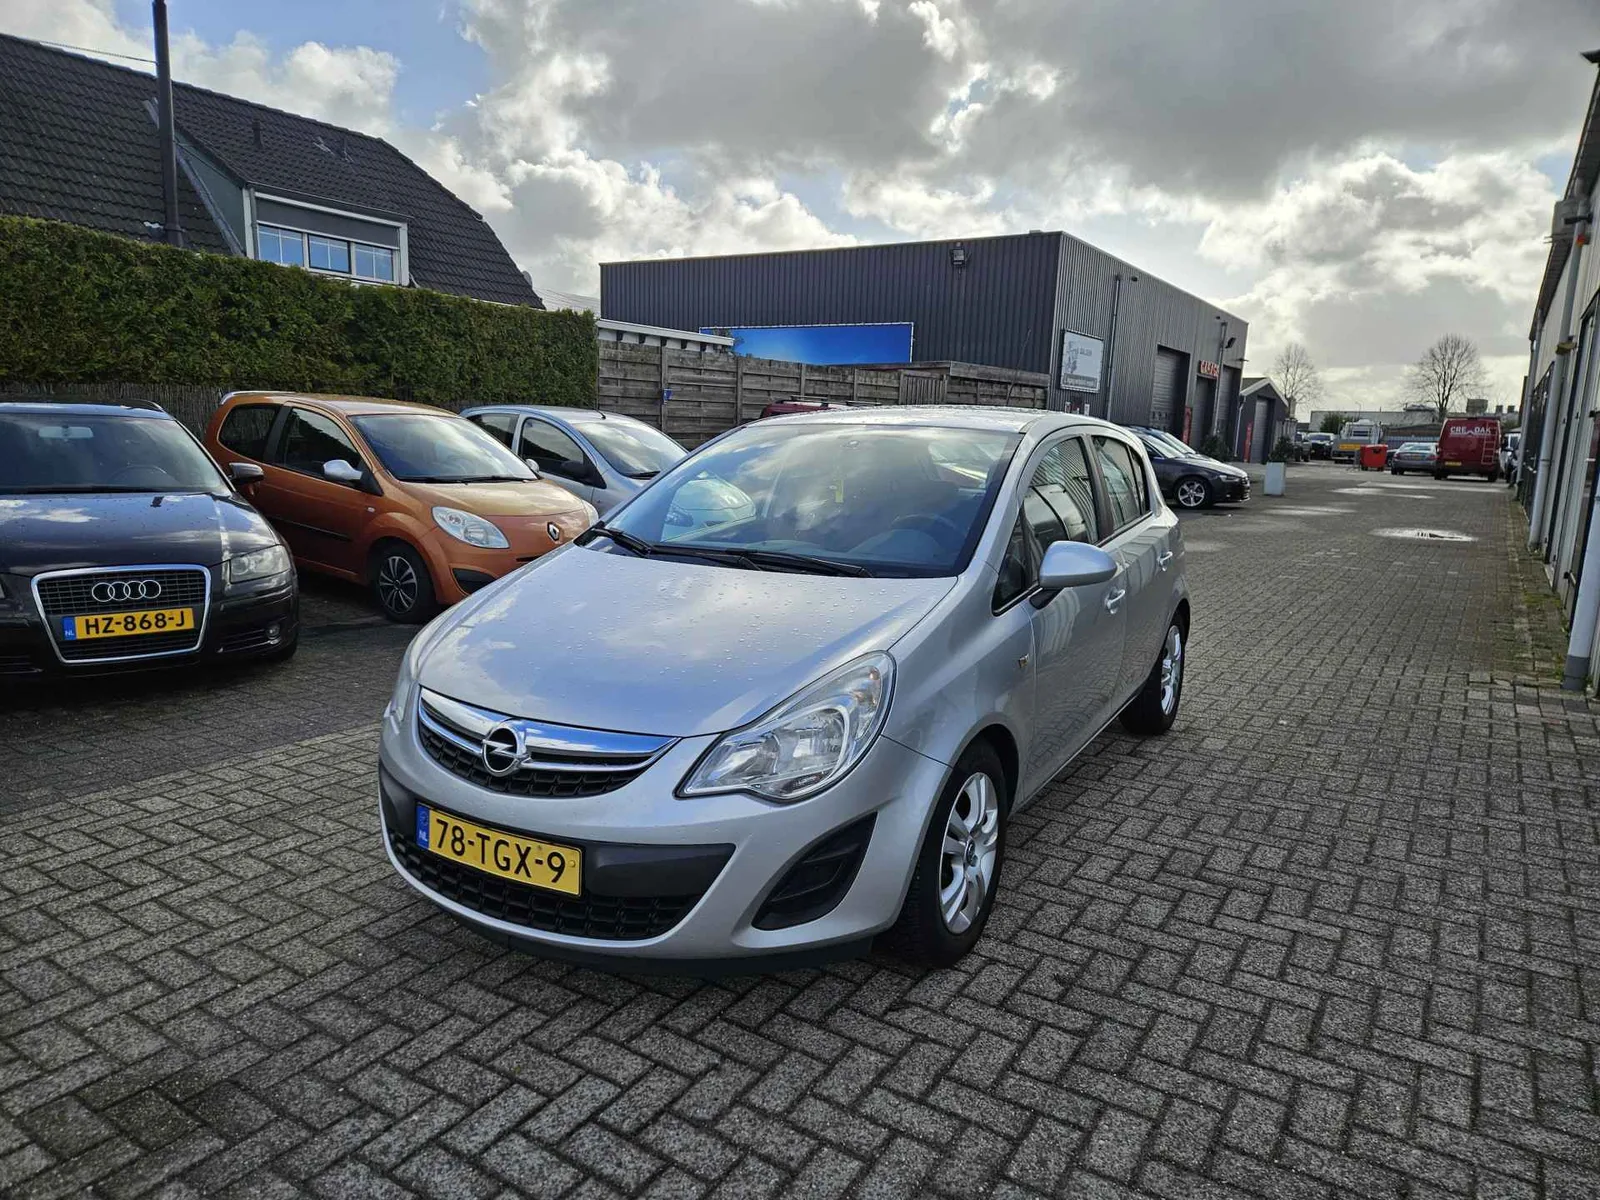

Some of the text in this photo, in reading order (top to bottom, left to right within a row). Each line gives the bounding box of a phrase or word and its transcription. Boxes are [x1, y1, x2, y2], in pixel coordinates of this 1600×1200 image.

[84, 610, 185, 635] HZ-868-J
[418, 818, 566, 883] NL 78-TGX-9
